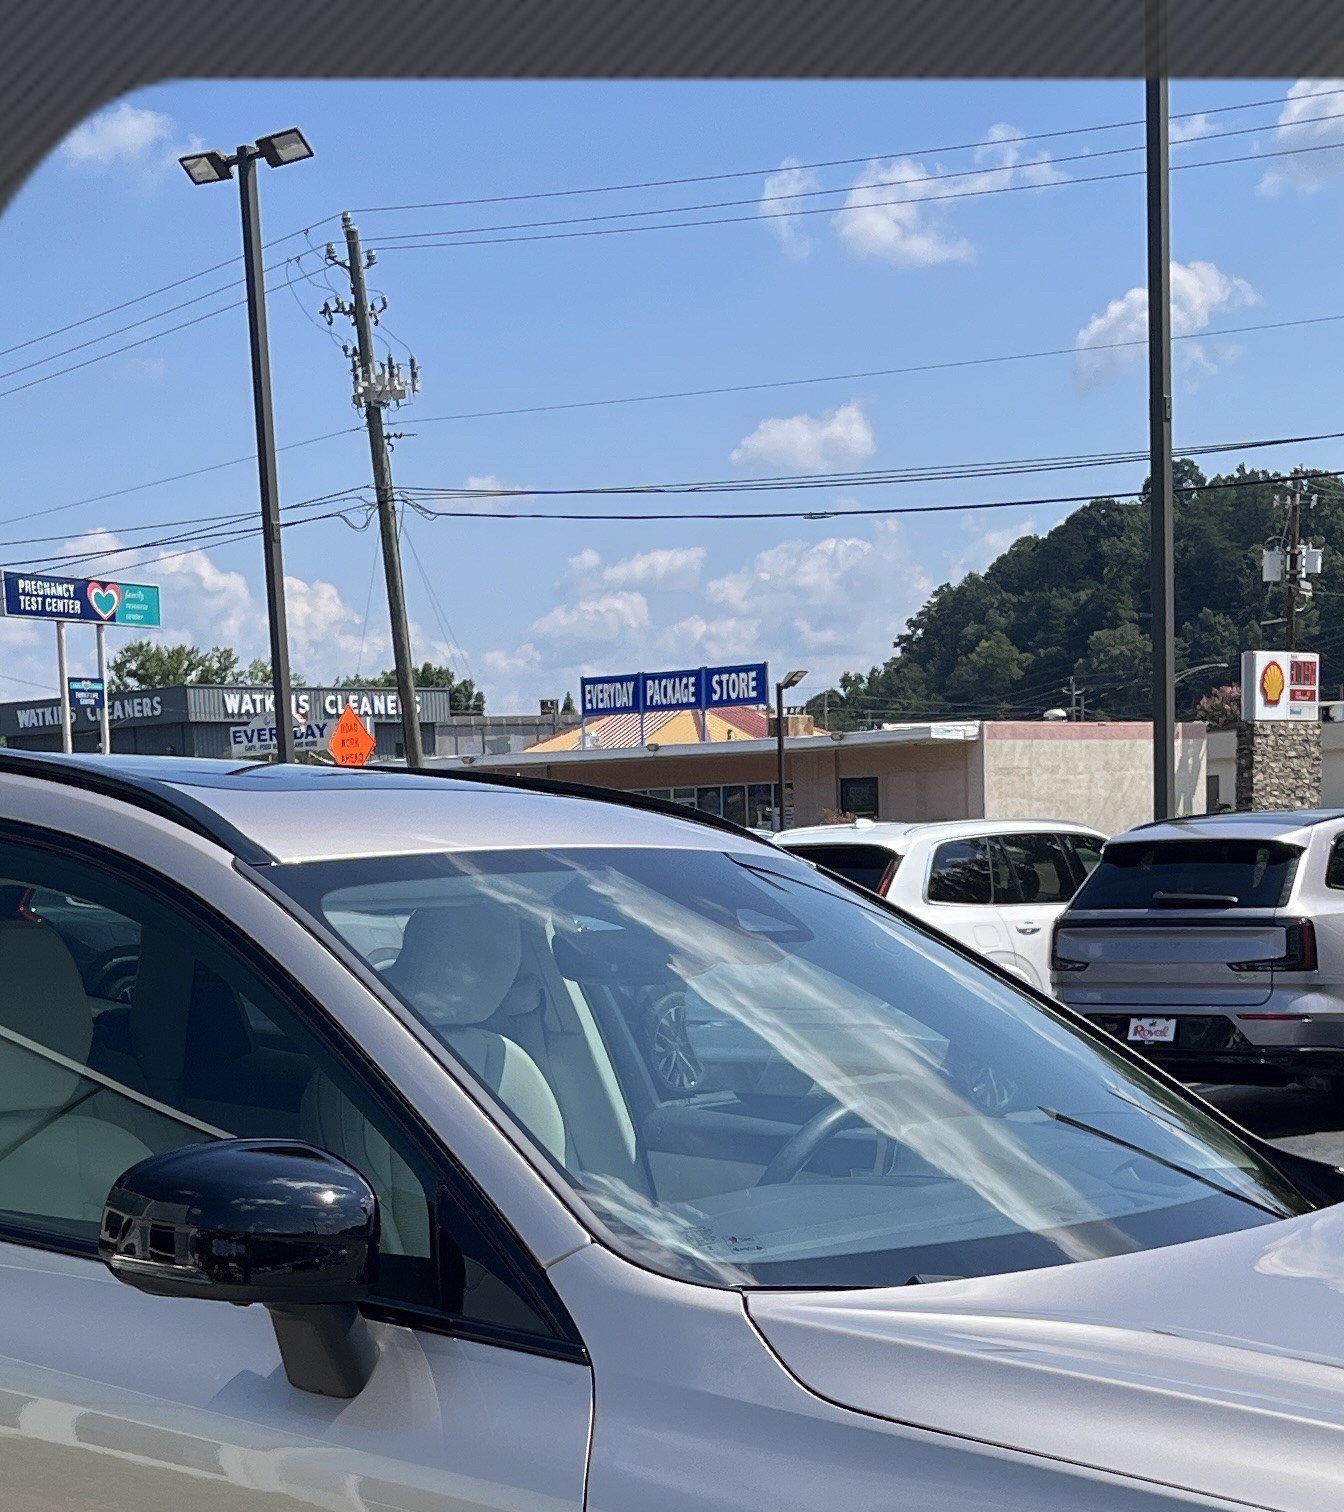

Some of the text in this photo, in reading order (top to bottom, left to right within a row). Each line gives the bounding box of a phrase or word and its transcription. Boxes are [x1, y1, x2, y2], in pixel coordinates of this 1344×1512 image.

[17, 578, 75, 598] PREGNANCY
[19, 595, 81, 614] TEST CENTER
[584, 670, 758, 710] EVERYDAY PACKAGE STORE
[232, 723, 328, 745] EVERDAY
[1132, 1024, 1170, 1040] Royal
